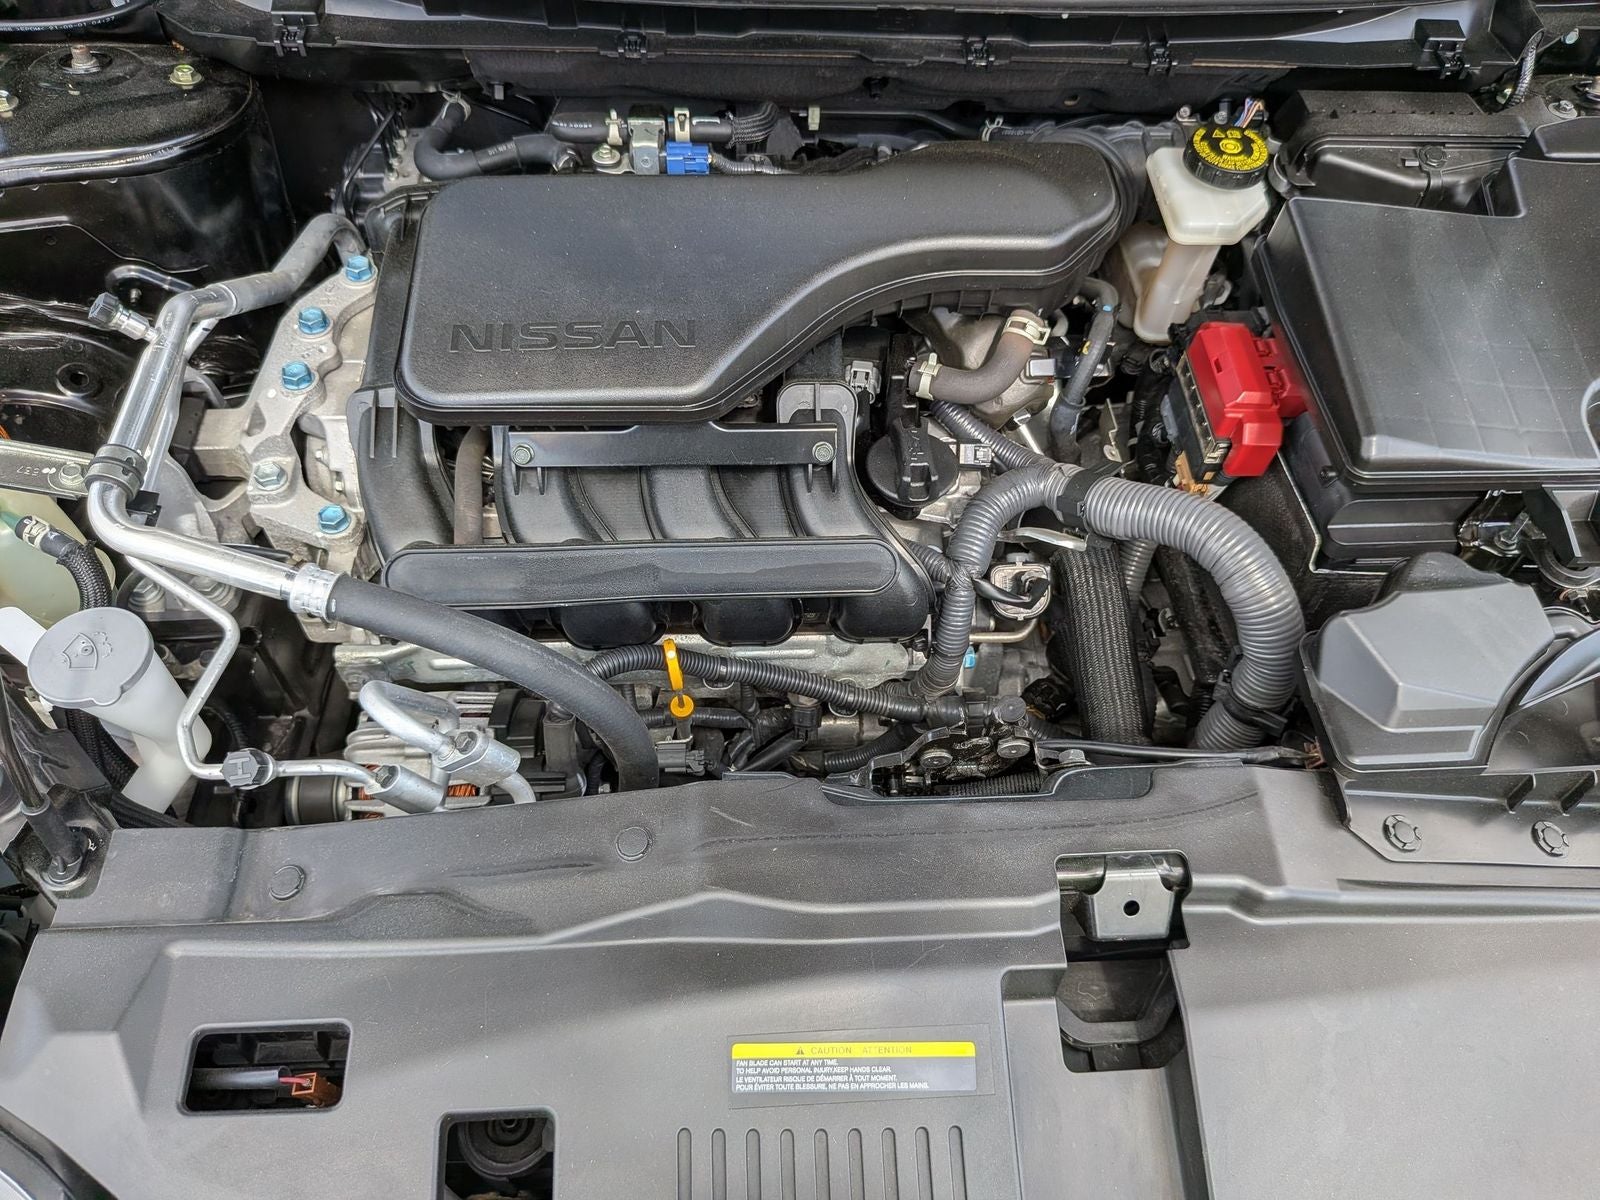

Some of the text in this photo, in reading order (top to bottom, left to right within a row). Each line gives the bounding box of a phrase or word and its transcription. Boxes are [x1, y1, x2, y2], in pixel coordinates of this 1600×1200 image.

[450, 320, 696, 352] NISSAN
[810, 1046, 912, 1055] CAUTION ATTENTION
[749, 1059, 768, 1067] BLADE
[769, 1059, 782, 1067] CAN
[736, 1067, 745, 1075] TO
[780, 1066, 812, 1074] PERSONAL
[849, 1065, 871, 1073] HANDS
[744, 1075, 783, 1083] VENTILATEUR
[783, 1075, 806, 1083] RISQUE
[815, 1074, 848, 1082] DÉMARRER
[754, 1082, 774, 1091] ÉVITER
[850, 1082, 859, 1090] EN
[859, 1081, 897, 1089] APPROCHER
[897, 1081, 909, 1089] LES
